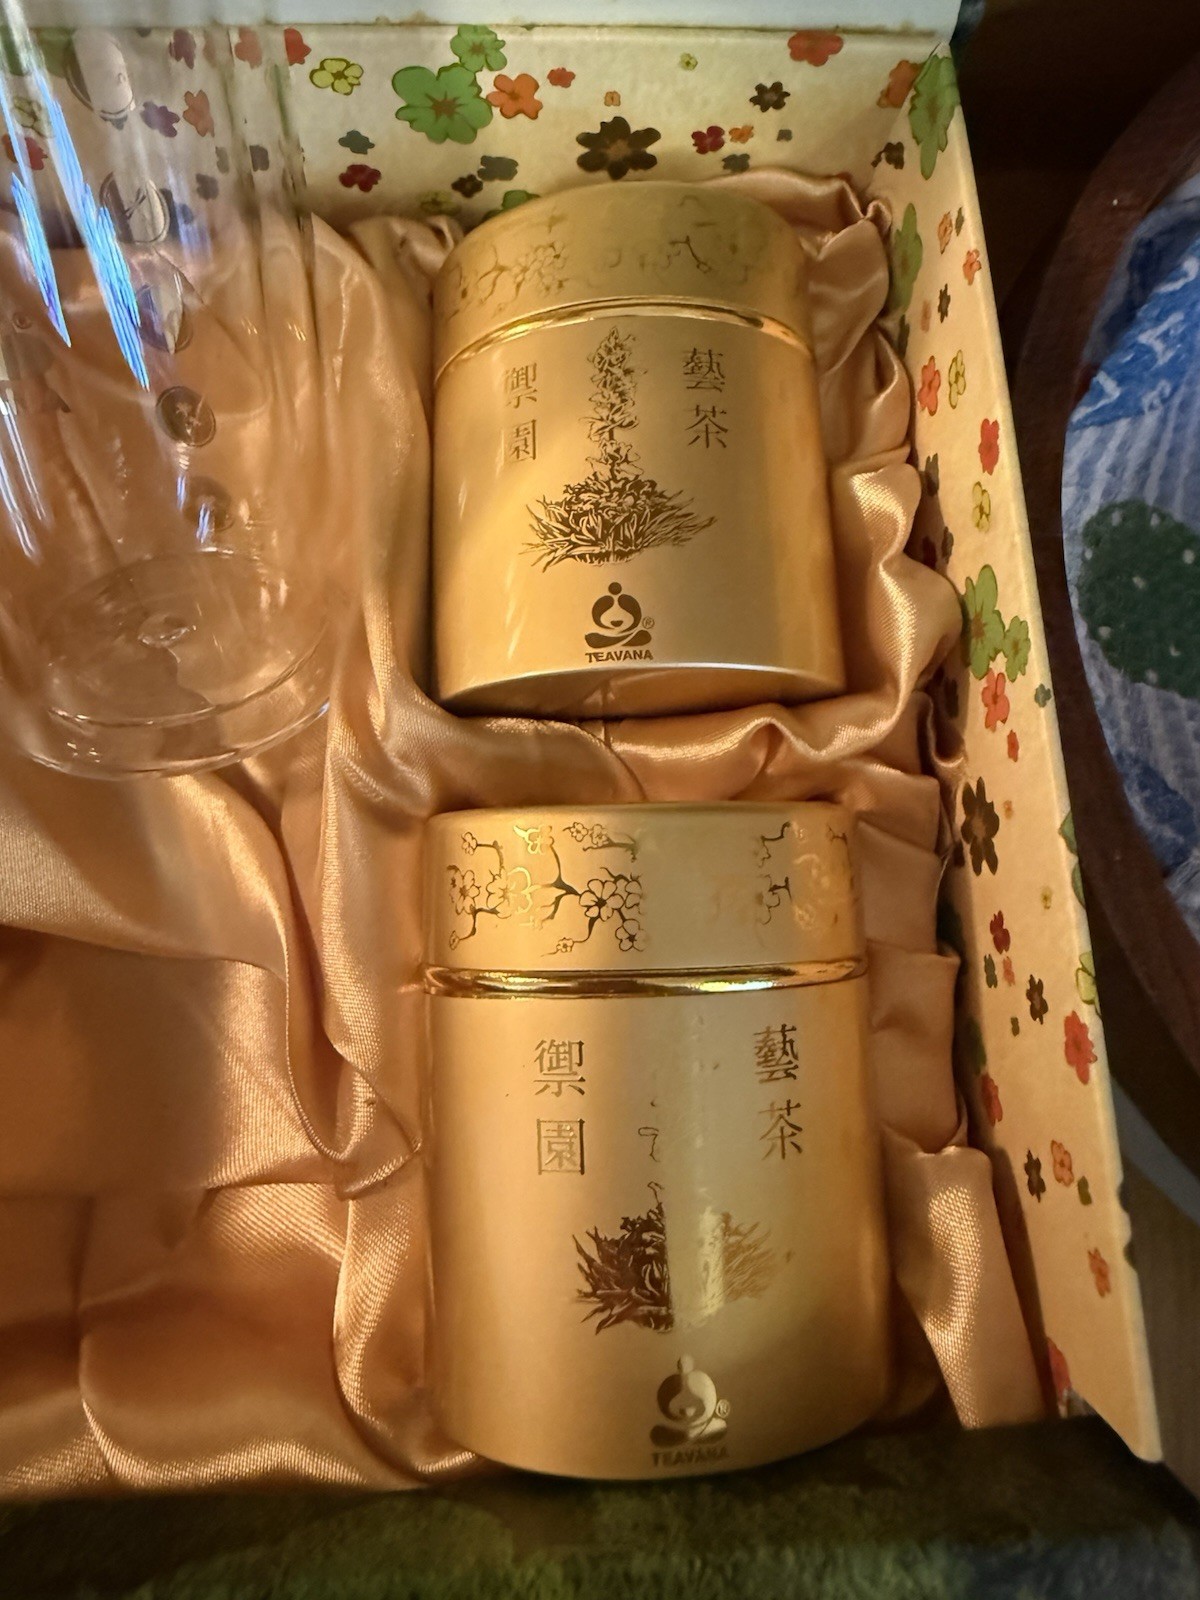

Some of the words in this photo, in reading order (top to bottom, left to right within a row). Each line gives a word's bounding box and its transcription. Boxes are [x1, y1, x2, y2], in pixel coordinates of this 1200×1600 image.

[682, 347, 728, 449] 藝茶
[585, 649, 653, 663] TEAVANA
[533, 1038, 586, 1176] 禦園
[753, 1023, 803, 1160] 藝茶
